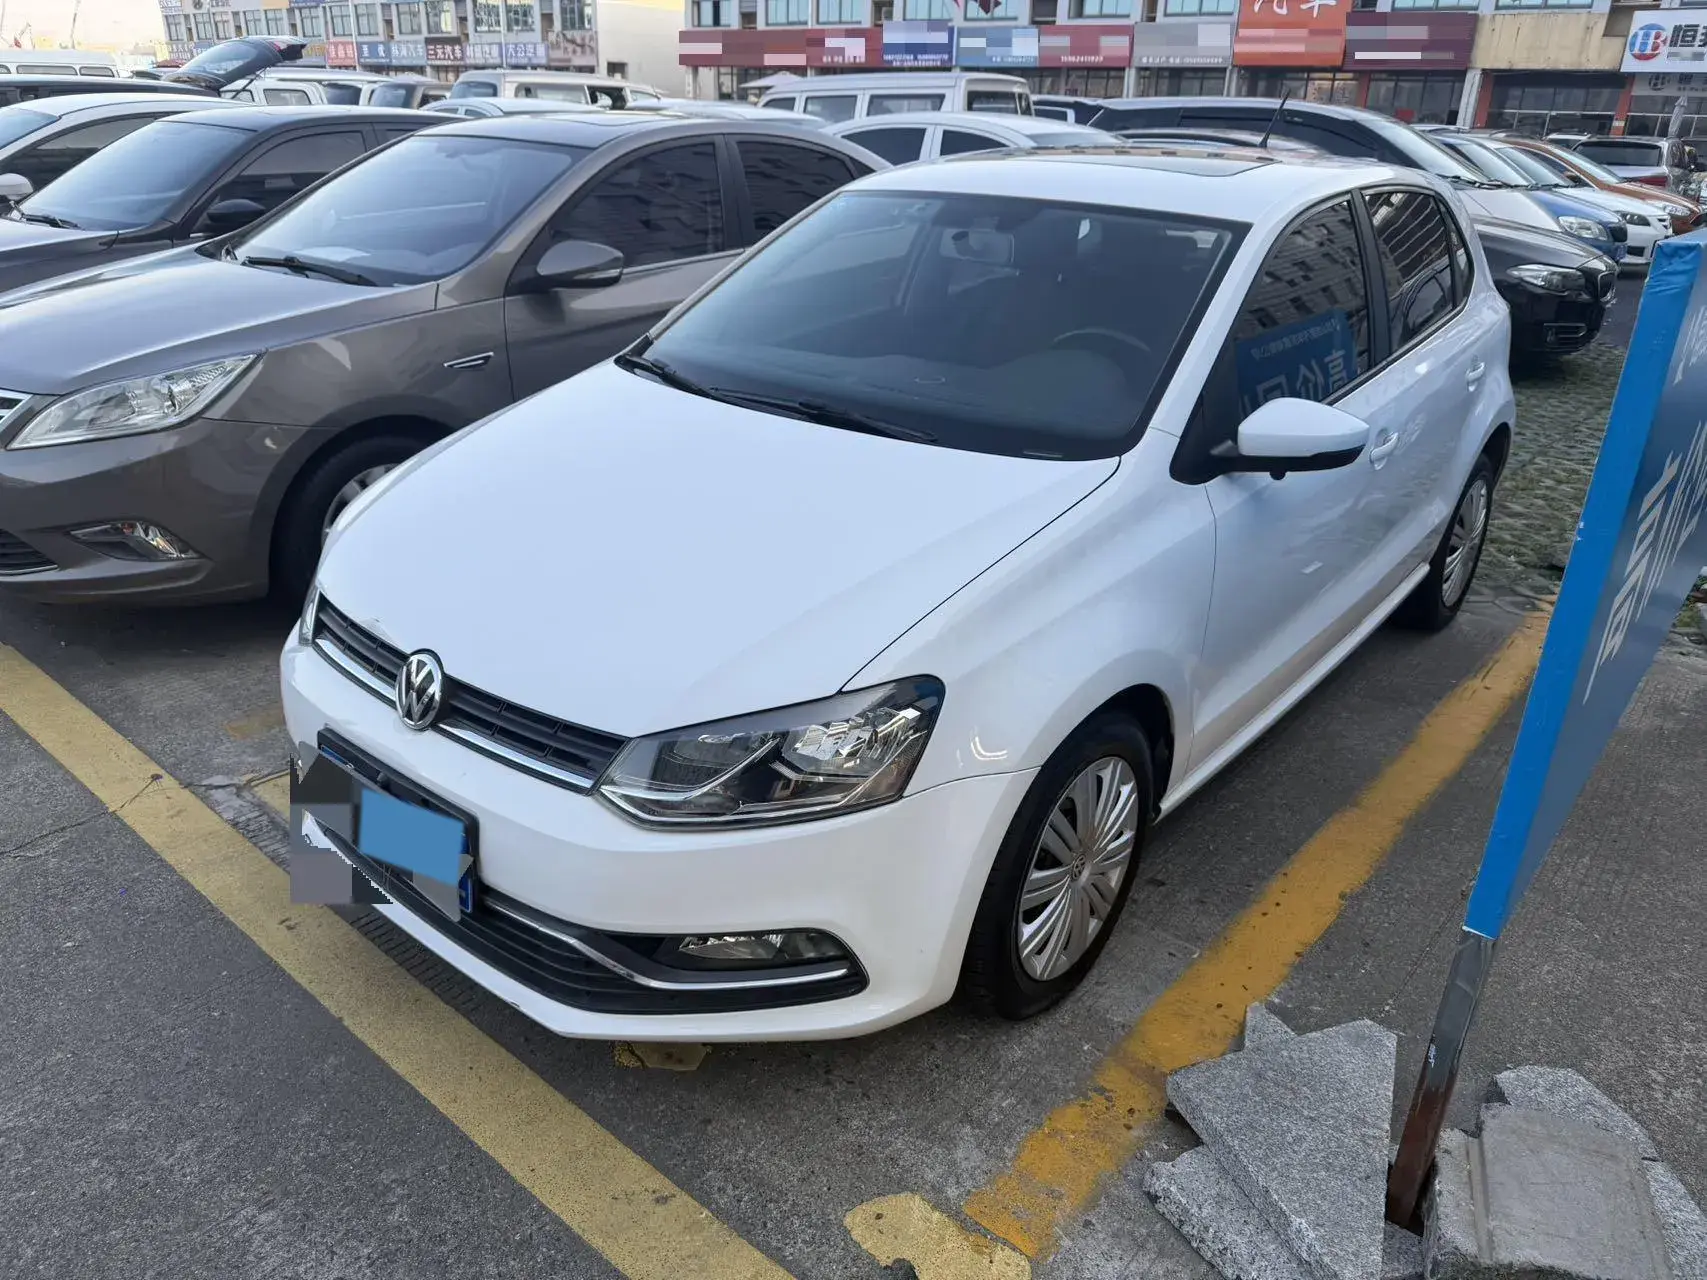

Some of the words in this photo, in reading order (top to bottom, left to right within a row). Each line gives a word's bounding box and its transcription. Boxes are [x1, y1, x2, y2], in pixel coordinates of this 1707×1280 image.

[1669, 24, 1707, 48] 恒
[427, 44, 462, 60] 三元汽车
